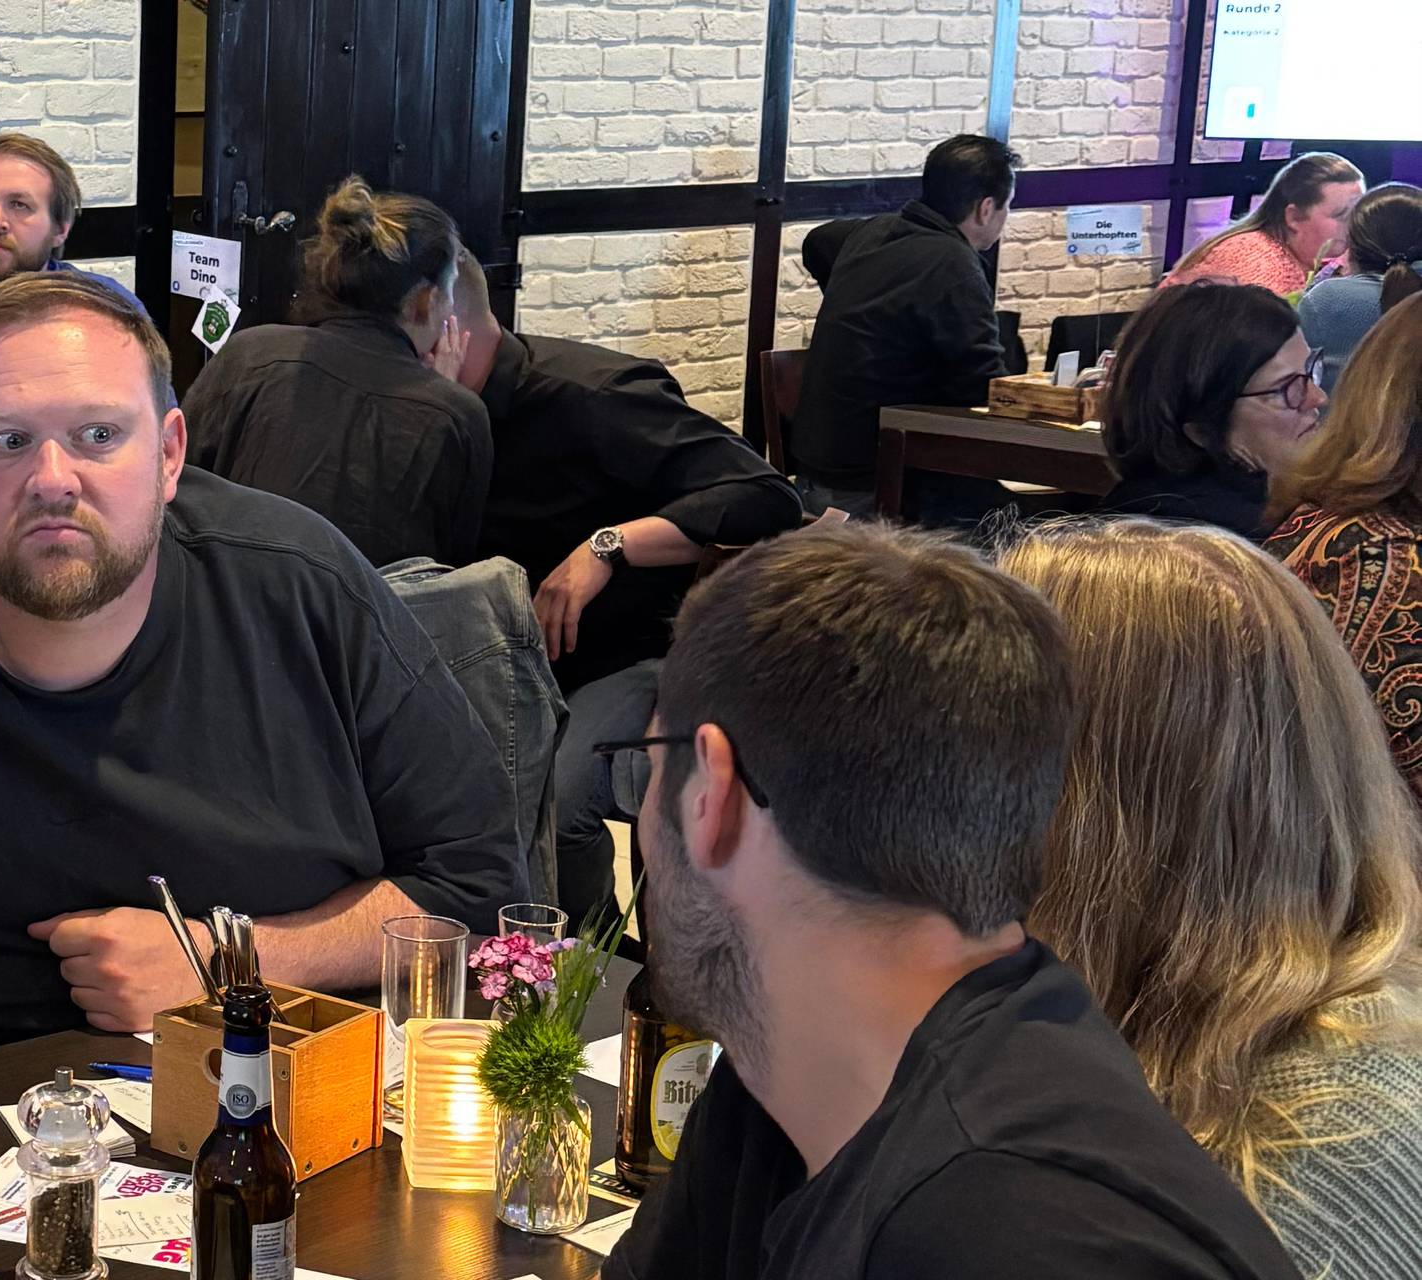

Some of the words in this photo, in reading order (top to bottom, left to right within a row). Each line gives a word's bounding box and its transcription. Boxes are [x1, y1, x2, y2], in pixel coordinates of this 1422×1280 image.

[1226, 3, 1270, 13] Runde
[1274, 3, 1281, 13] 2
[1096, 221, 1112, 229] Die
[1071, 231, 1137, 240] Unterhopften
[189, 251, 220, 267] Team
[190, 269, 217, 284] Dino
